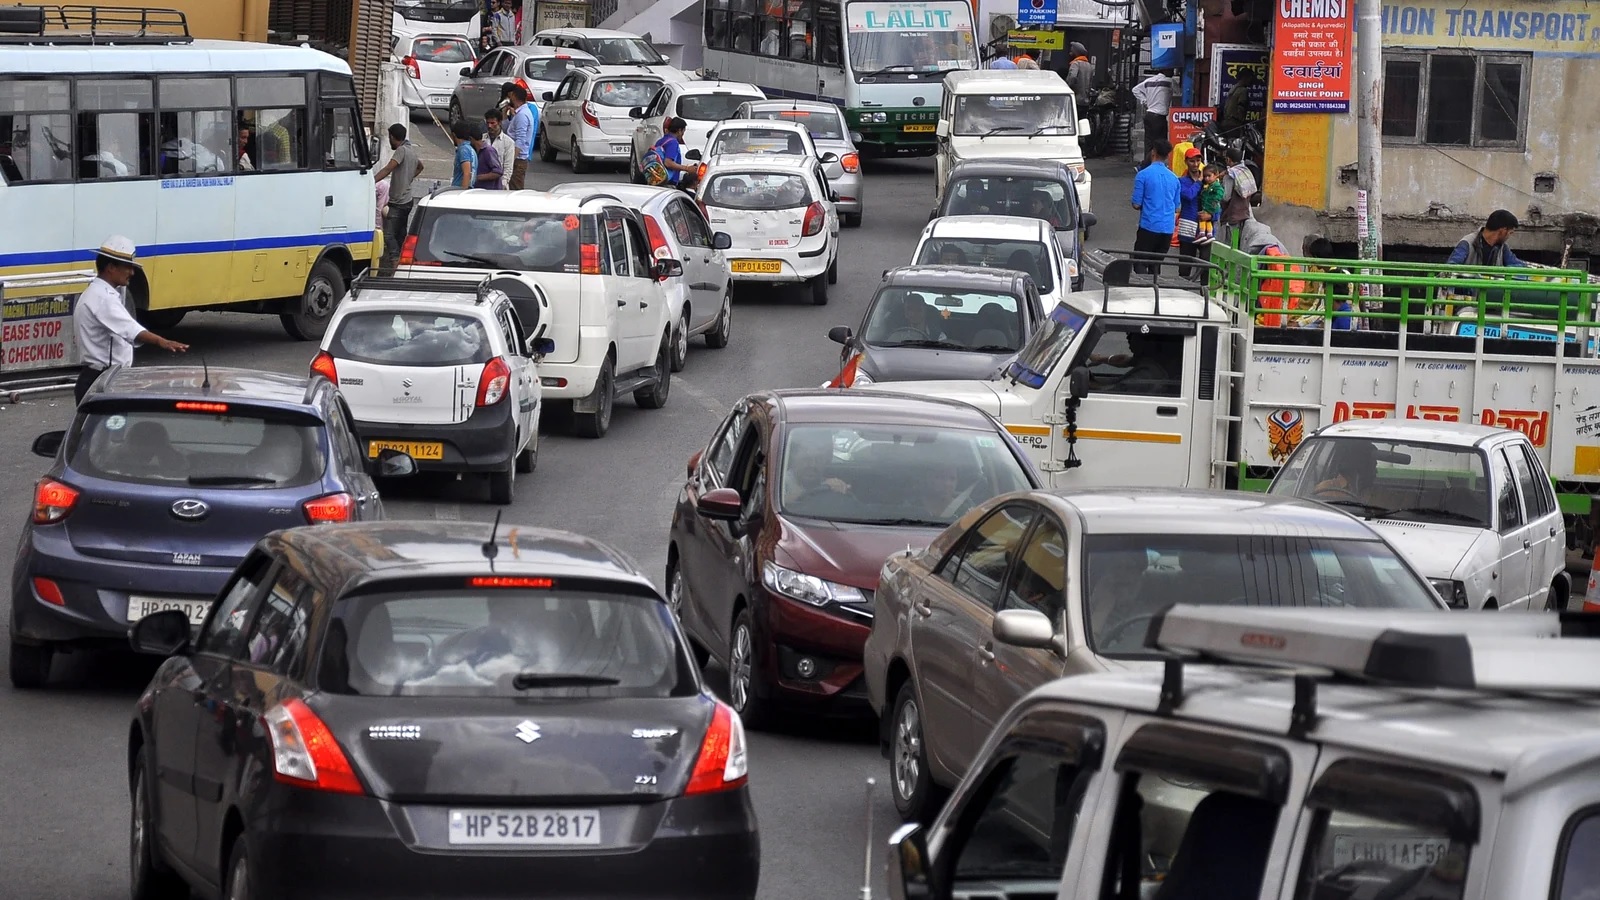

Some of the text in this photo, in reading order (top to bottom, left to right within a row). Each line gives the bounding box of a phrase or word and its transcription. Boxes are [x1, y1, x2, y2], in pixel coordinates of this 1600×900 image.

[1280, 0, 1346, 18] CHEMIST
[865, 10, 951, 28] LALIT
[1381, 5, 1435, 35] NION
[1445, 8, 1591, 41] TRANSPORT
[1291, 40, 1306, 48] सभी
[1328, 40, 1338, 48] की
[1293, 31, 1308, 39] हमारे
[1281, 60, 1343, 80] दवाईयां
[1172, 112, 1214, 123] CHEMIST
[3, 321, 61, 342] EASE STOP
[8, 343, 64, 363] CHECKING
[414, 447, 439, 456] 1124
[466, 815, 595, 837] HP 52B 2817
